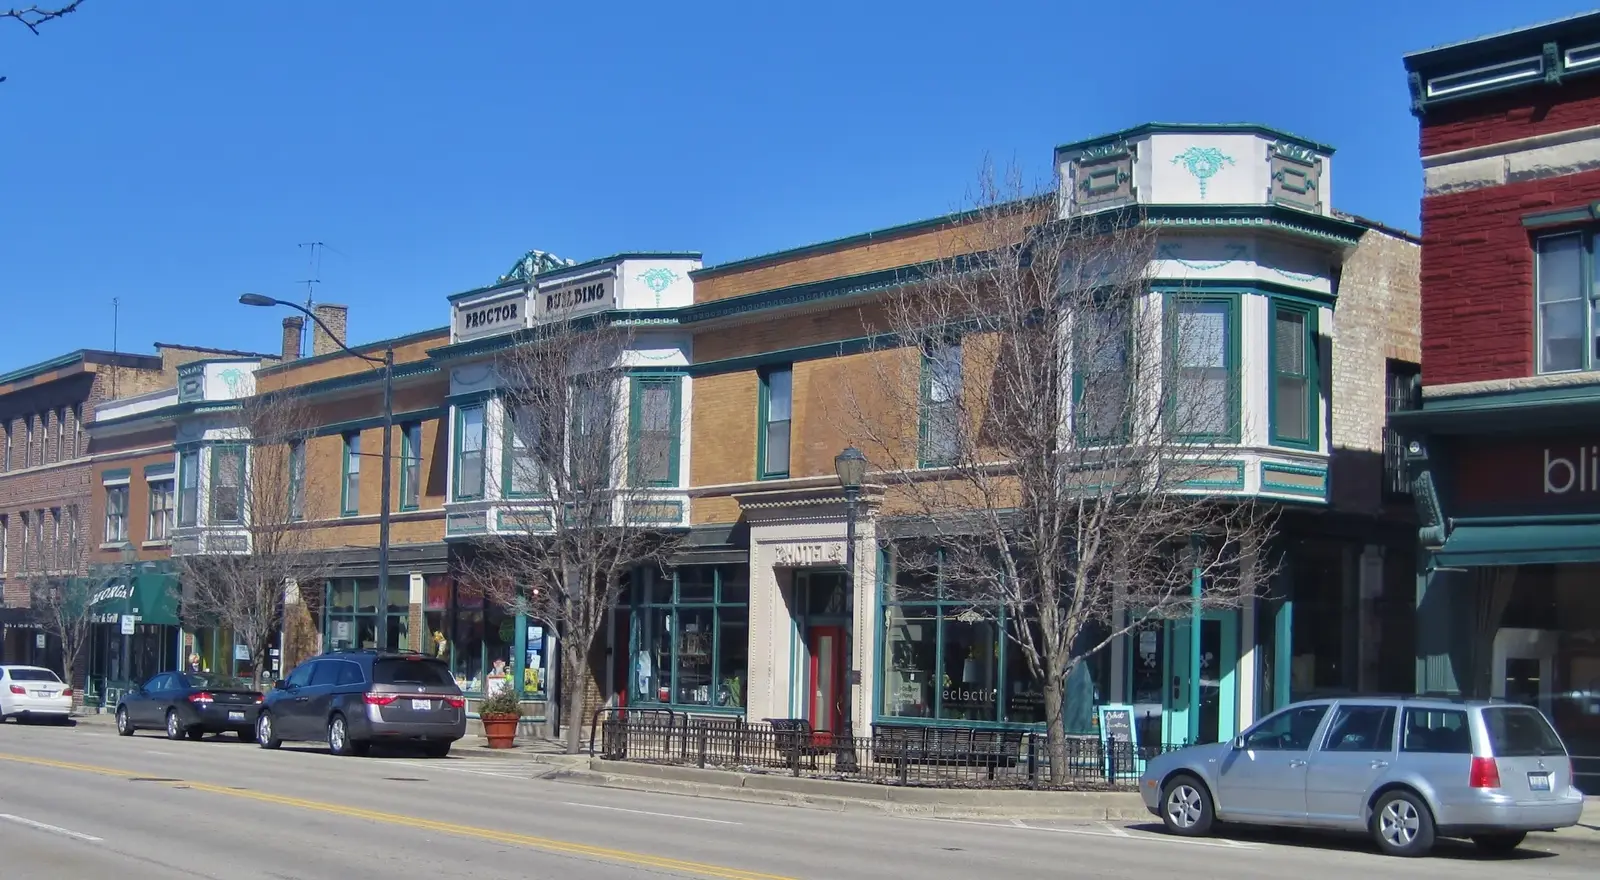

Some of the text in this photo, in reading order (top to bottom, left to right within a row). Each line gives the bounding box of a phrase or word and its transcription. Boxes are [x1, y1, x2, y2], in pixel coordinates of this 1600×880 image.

[465, 283, 605, 329] PROCTOR BULDING
[1543, 445, 1598, 494] bli
